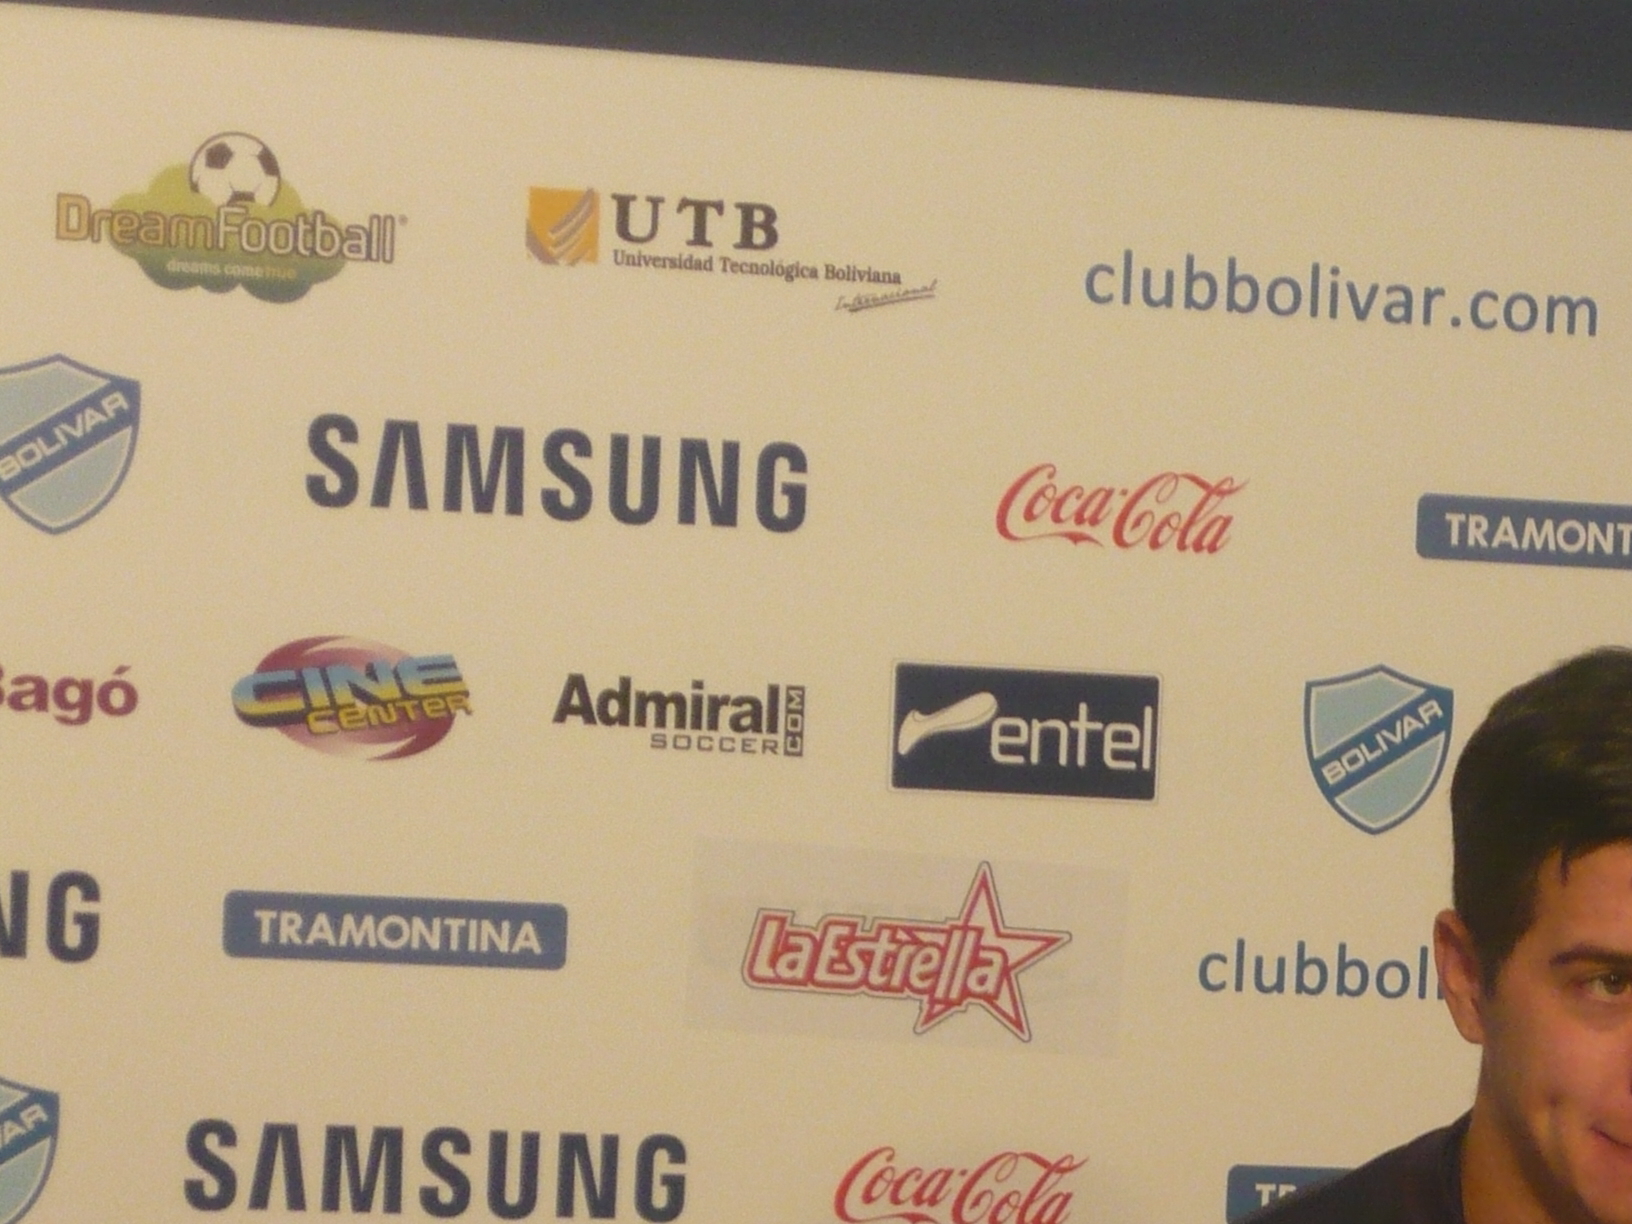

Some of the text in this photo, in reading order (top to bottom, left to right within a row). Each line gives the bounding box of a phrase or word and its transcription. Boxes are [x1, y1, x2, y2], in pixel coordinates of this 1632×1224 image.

[55, 192, 396, 264] DreamFootball
[611, 193, 779, 250] UTB
[613, 249, 902, 285] Universidad Tecnológica Boliviana
[1085, 249, 1599, 337] clubbolivar.com
[305, 413, 809, 534] SAMSUNG
[995, 463, 1250, 555] Coca-Cola
[0, 663, 138, 727] agó
[231, 653, 470, 727] CINE
[551, 673, 780, 734] Admiral
[650, 733, 778, 755] SOCCER
[989, 701, 1154, 773] entel
[1321, 697, 1444, 787] BOLIVAR
[254, 909, 542, 955] TRAMONTINA
[1198, 937, 1446, 1000] clubbol
[184, 1118, 687, 1224] SAMSUNG
